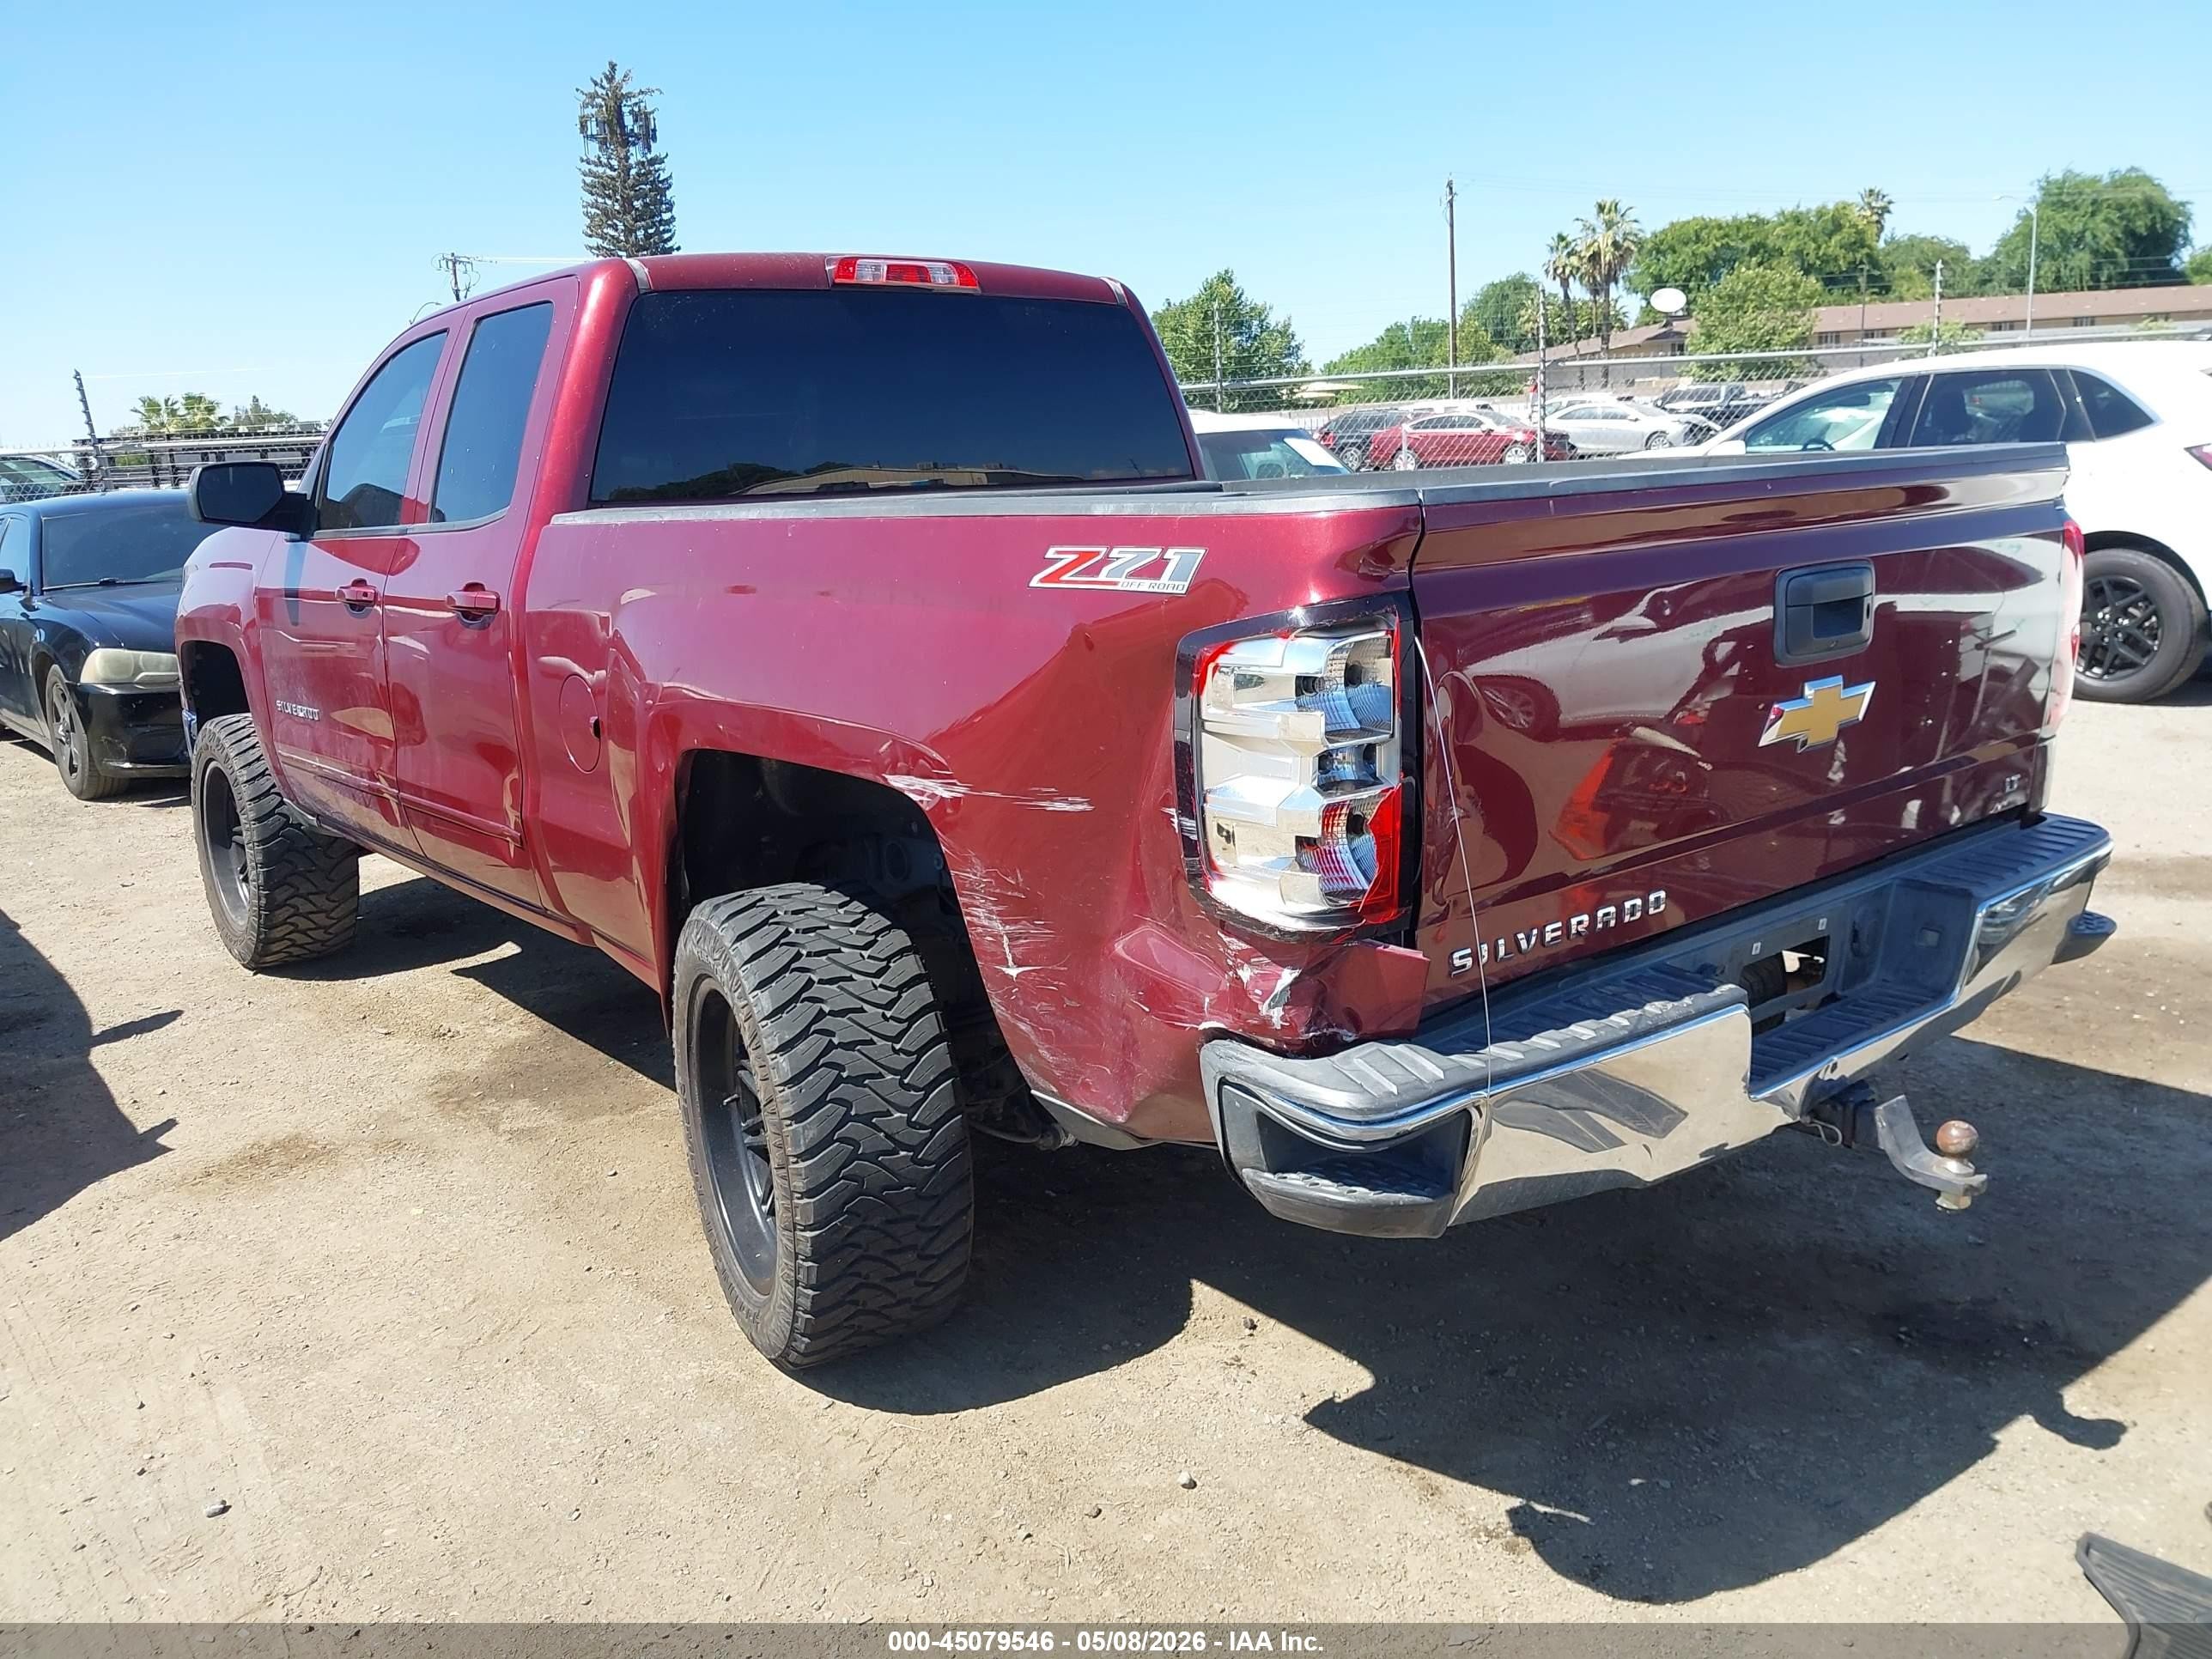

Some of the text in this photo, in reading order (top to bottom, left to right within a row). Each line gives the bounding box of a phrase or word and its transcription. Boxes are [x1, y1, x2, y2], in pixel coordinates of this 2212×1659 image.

[1028, 547, 1207, 594] Z71
[1121, 580, 1186, 592] OFF ROAD
[1449, 890, 1667, 977] SILVERADO
